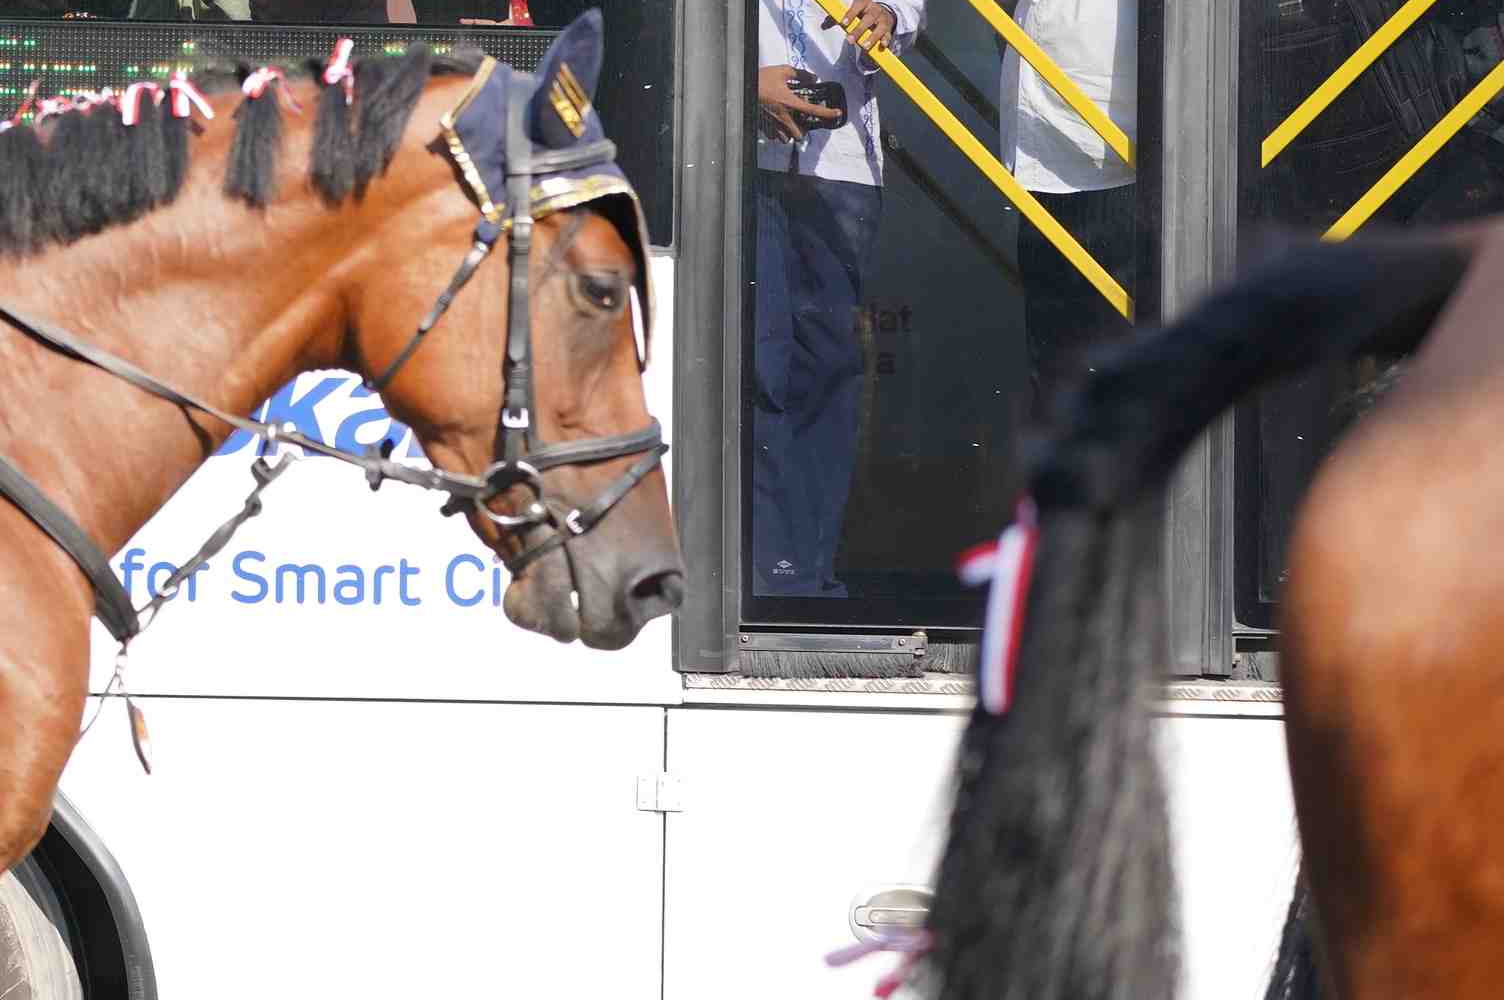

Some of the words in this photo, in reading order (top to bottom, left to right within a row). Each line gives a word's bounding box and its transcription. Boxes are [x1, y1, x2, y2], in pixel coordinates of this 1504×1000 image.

[120, 548, 210, 602] for
[231, 550, 422, 606] Smart
[445, 553, 501, 608] Ci
